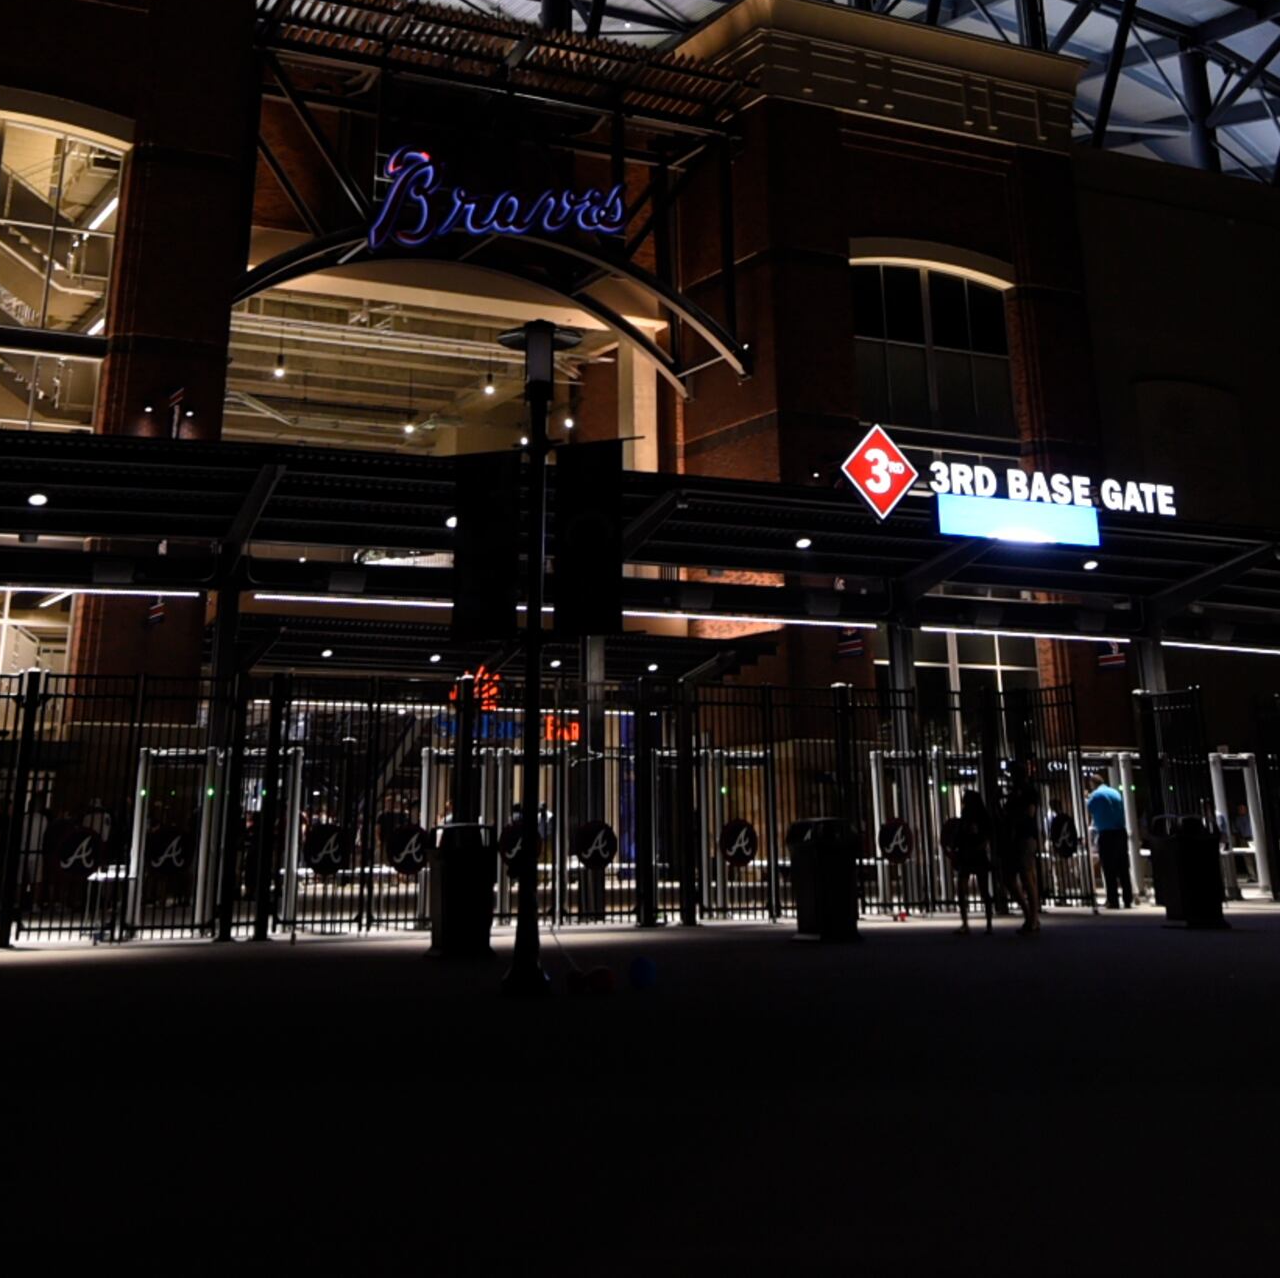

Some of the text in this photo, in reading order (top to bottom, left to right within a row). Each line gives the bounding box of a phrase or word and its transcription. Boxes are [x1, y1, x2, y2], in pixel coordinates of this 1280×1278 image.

[929, 460, 1177, 516] 3RD BASE GATE
[59, 835, 95, 869] A
[151, 835, 185, 868] A
[393, 832, 424, 863] A
[581, 828, 610, 859] A
[726, 827, 752, 856] A
[884, 825, 908, 853] A
